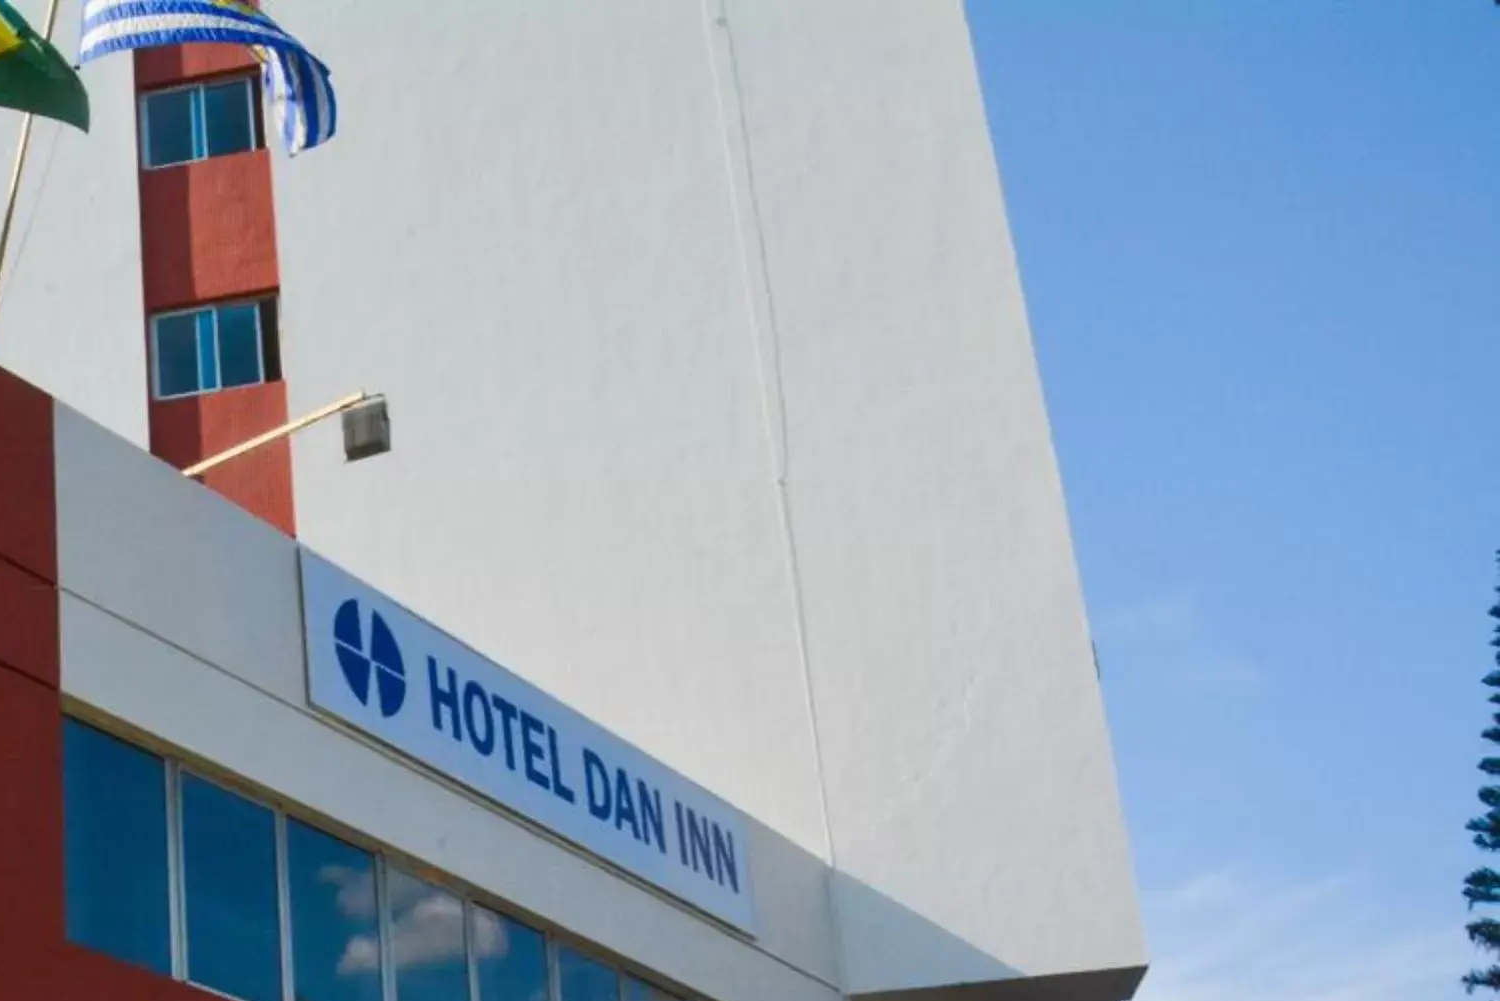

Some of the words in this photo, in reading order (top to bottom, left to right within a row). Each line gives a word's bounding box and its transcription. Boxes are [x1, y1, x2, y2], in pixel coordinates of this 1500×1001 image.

[426, 655, 575, 804] HOTEL
[582, 746, 667, 854] DAN
[674, 798, 741, 895] INN
